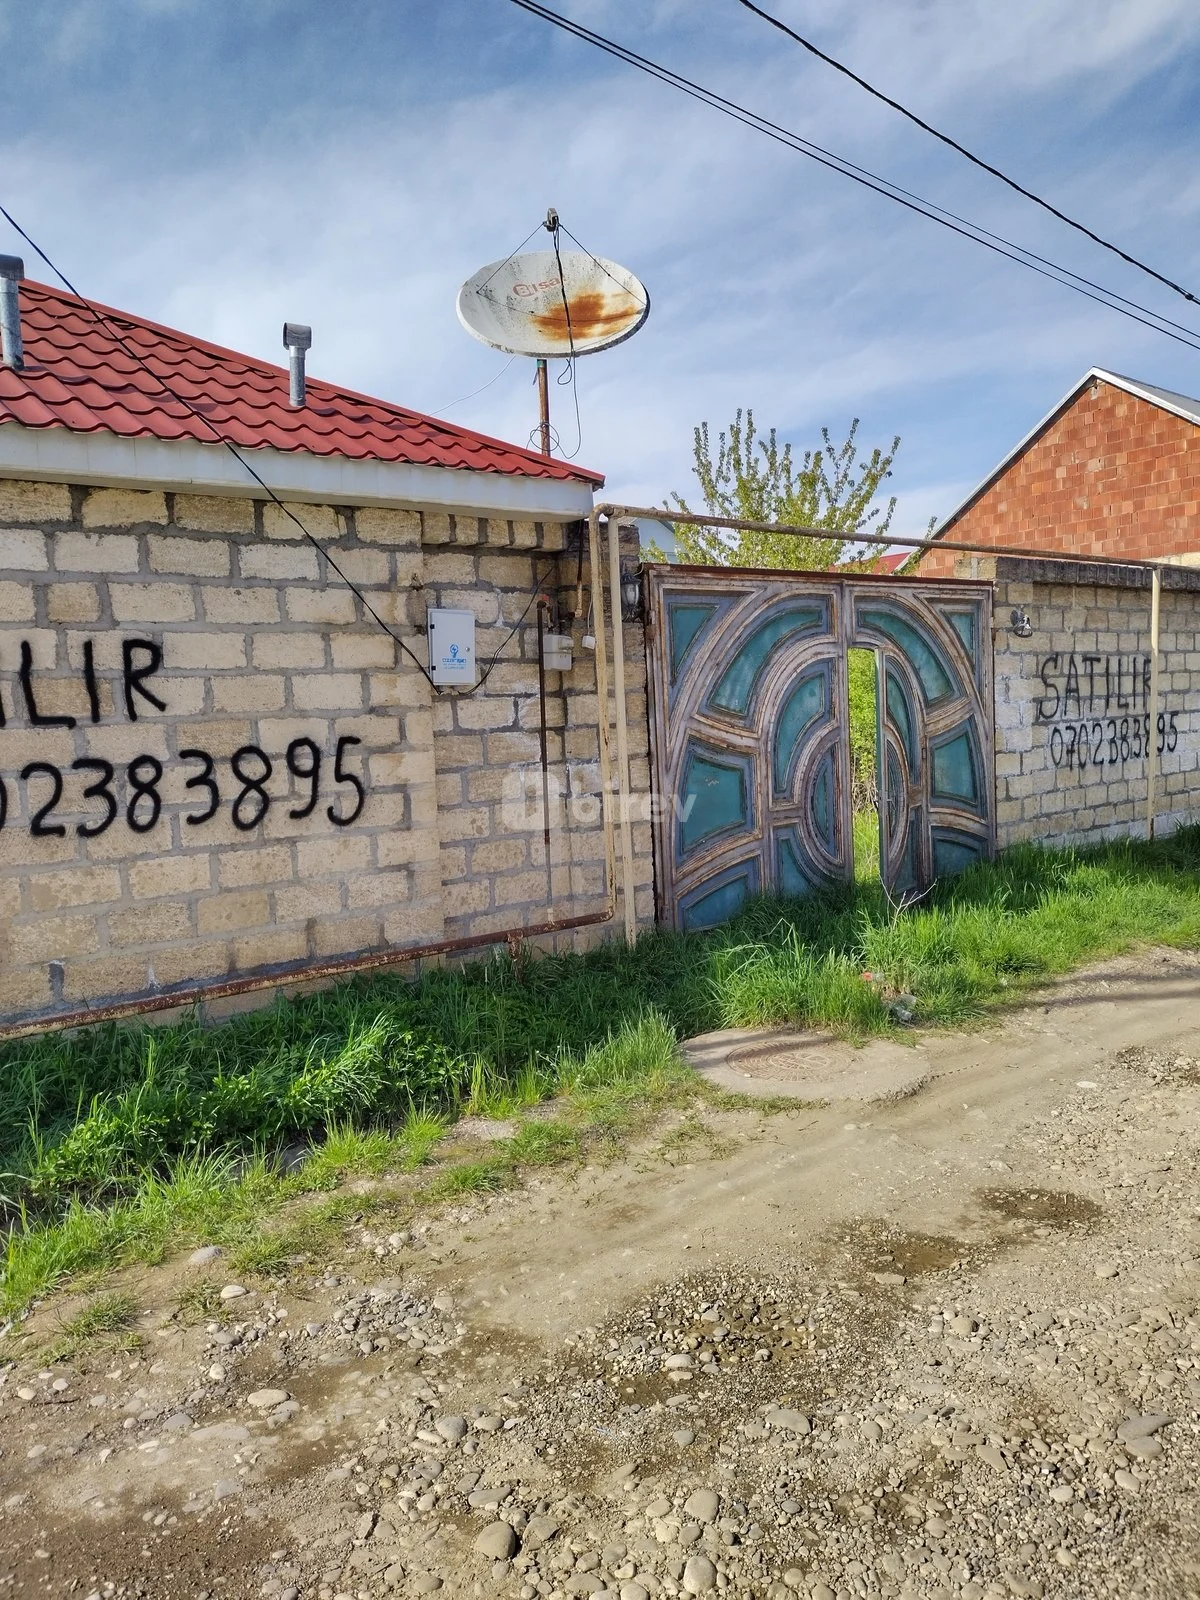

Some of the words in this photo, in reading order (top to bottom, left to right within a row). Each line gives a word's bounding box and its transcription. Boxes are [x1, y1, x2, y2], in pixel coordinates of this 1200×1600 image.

[0, 639, 168, 729] LIR
[1039, 652, 1152, 719] SATILIR
[1051, 711, 1179, 771] 0702383895
[0, 737, 365, 837] 2383895
